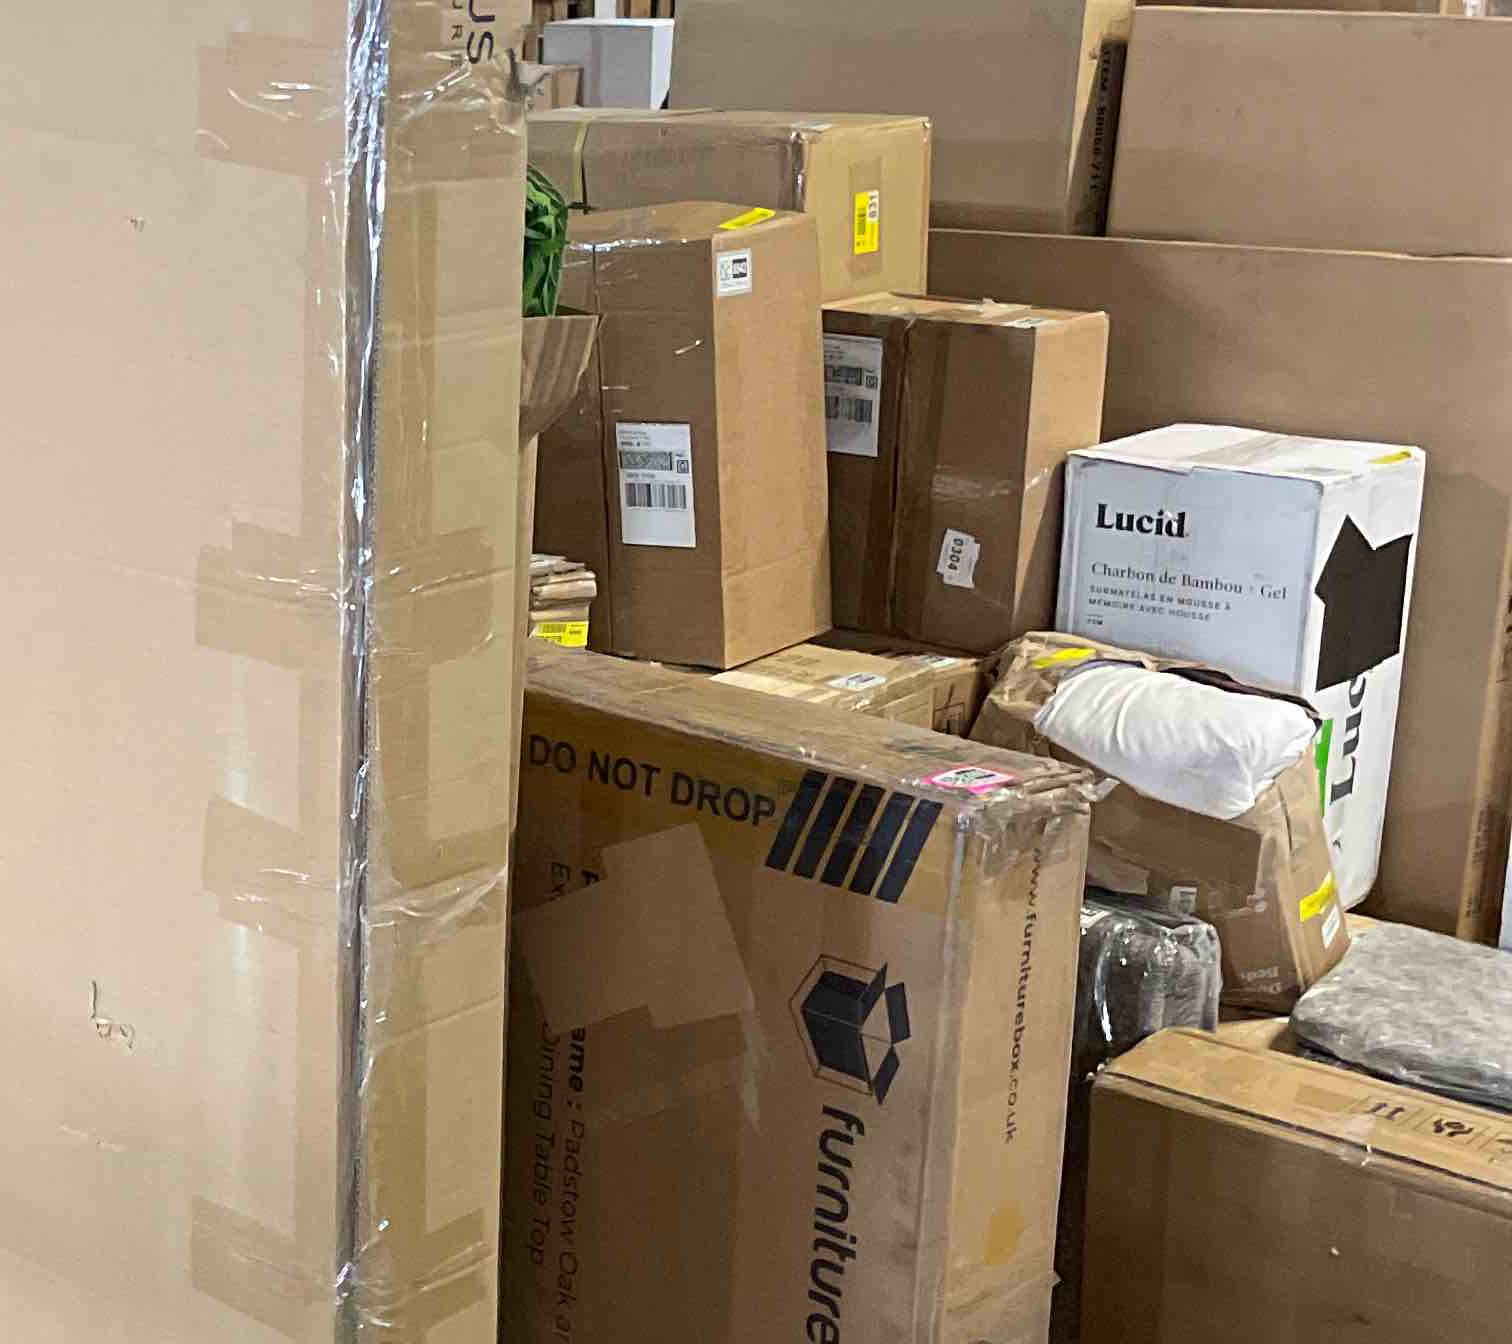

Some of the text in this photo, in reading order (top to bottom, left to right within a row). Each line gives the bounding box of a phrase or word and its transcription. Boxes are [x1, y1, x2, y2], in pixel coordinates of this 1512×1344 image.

[1096, 503, 1187, 538] Lucid
[1091, 562, 1155, 584] Charbon
[1159, 568, 1177, 585] de
[1181, 573, 1243, 595] Bambou
[1260, 585, 1287, 600] Gel
[1329, 674, 1366, 806] Luc
[529, 734, 776, 827] DO NOT DROP
[568, 1027, 586, 1093] ame
[534, 1132, 555, 1207] Table
[561, 1119, 585, 1239] Padstow
[528, 1216, 550, 1265] Top
[557, 1251, 579, 1308] Oak
